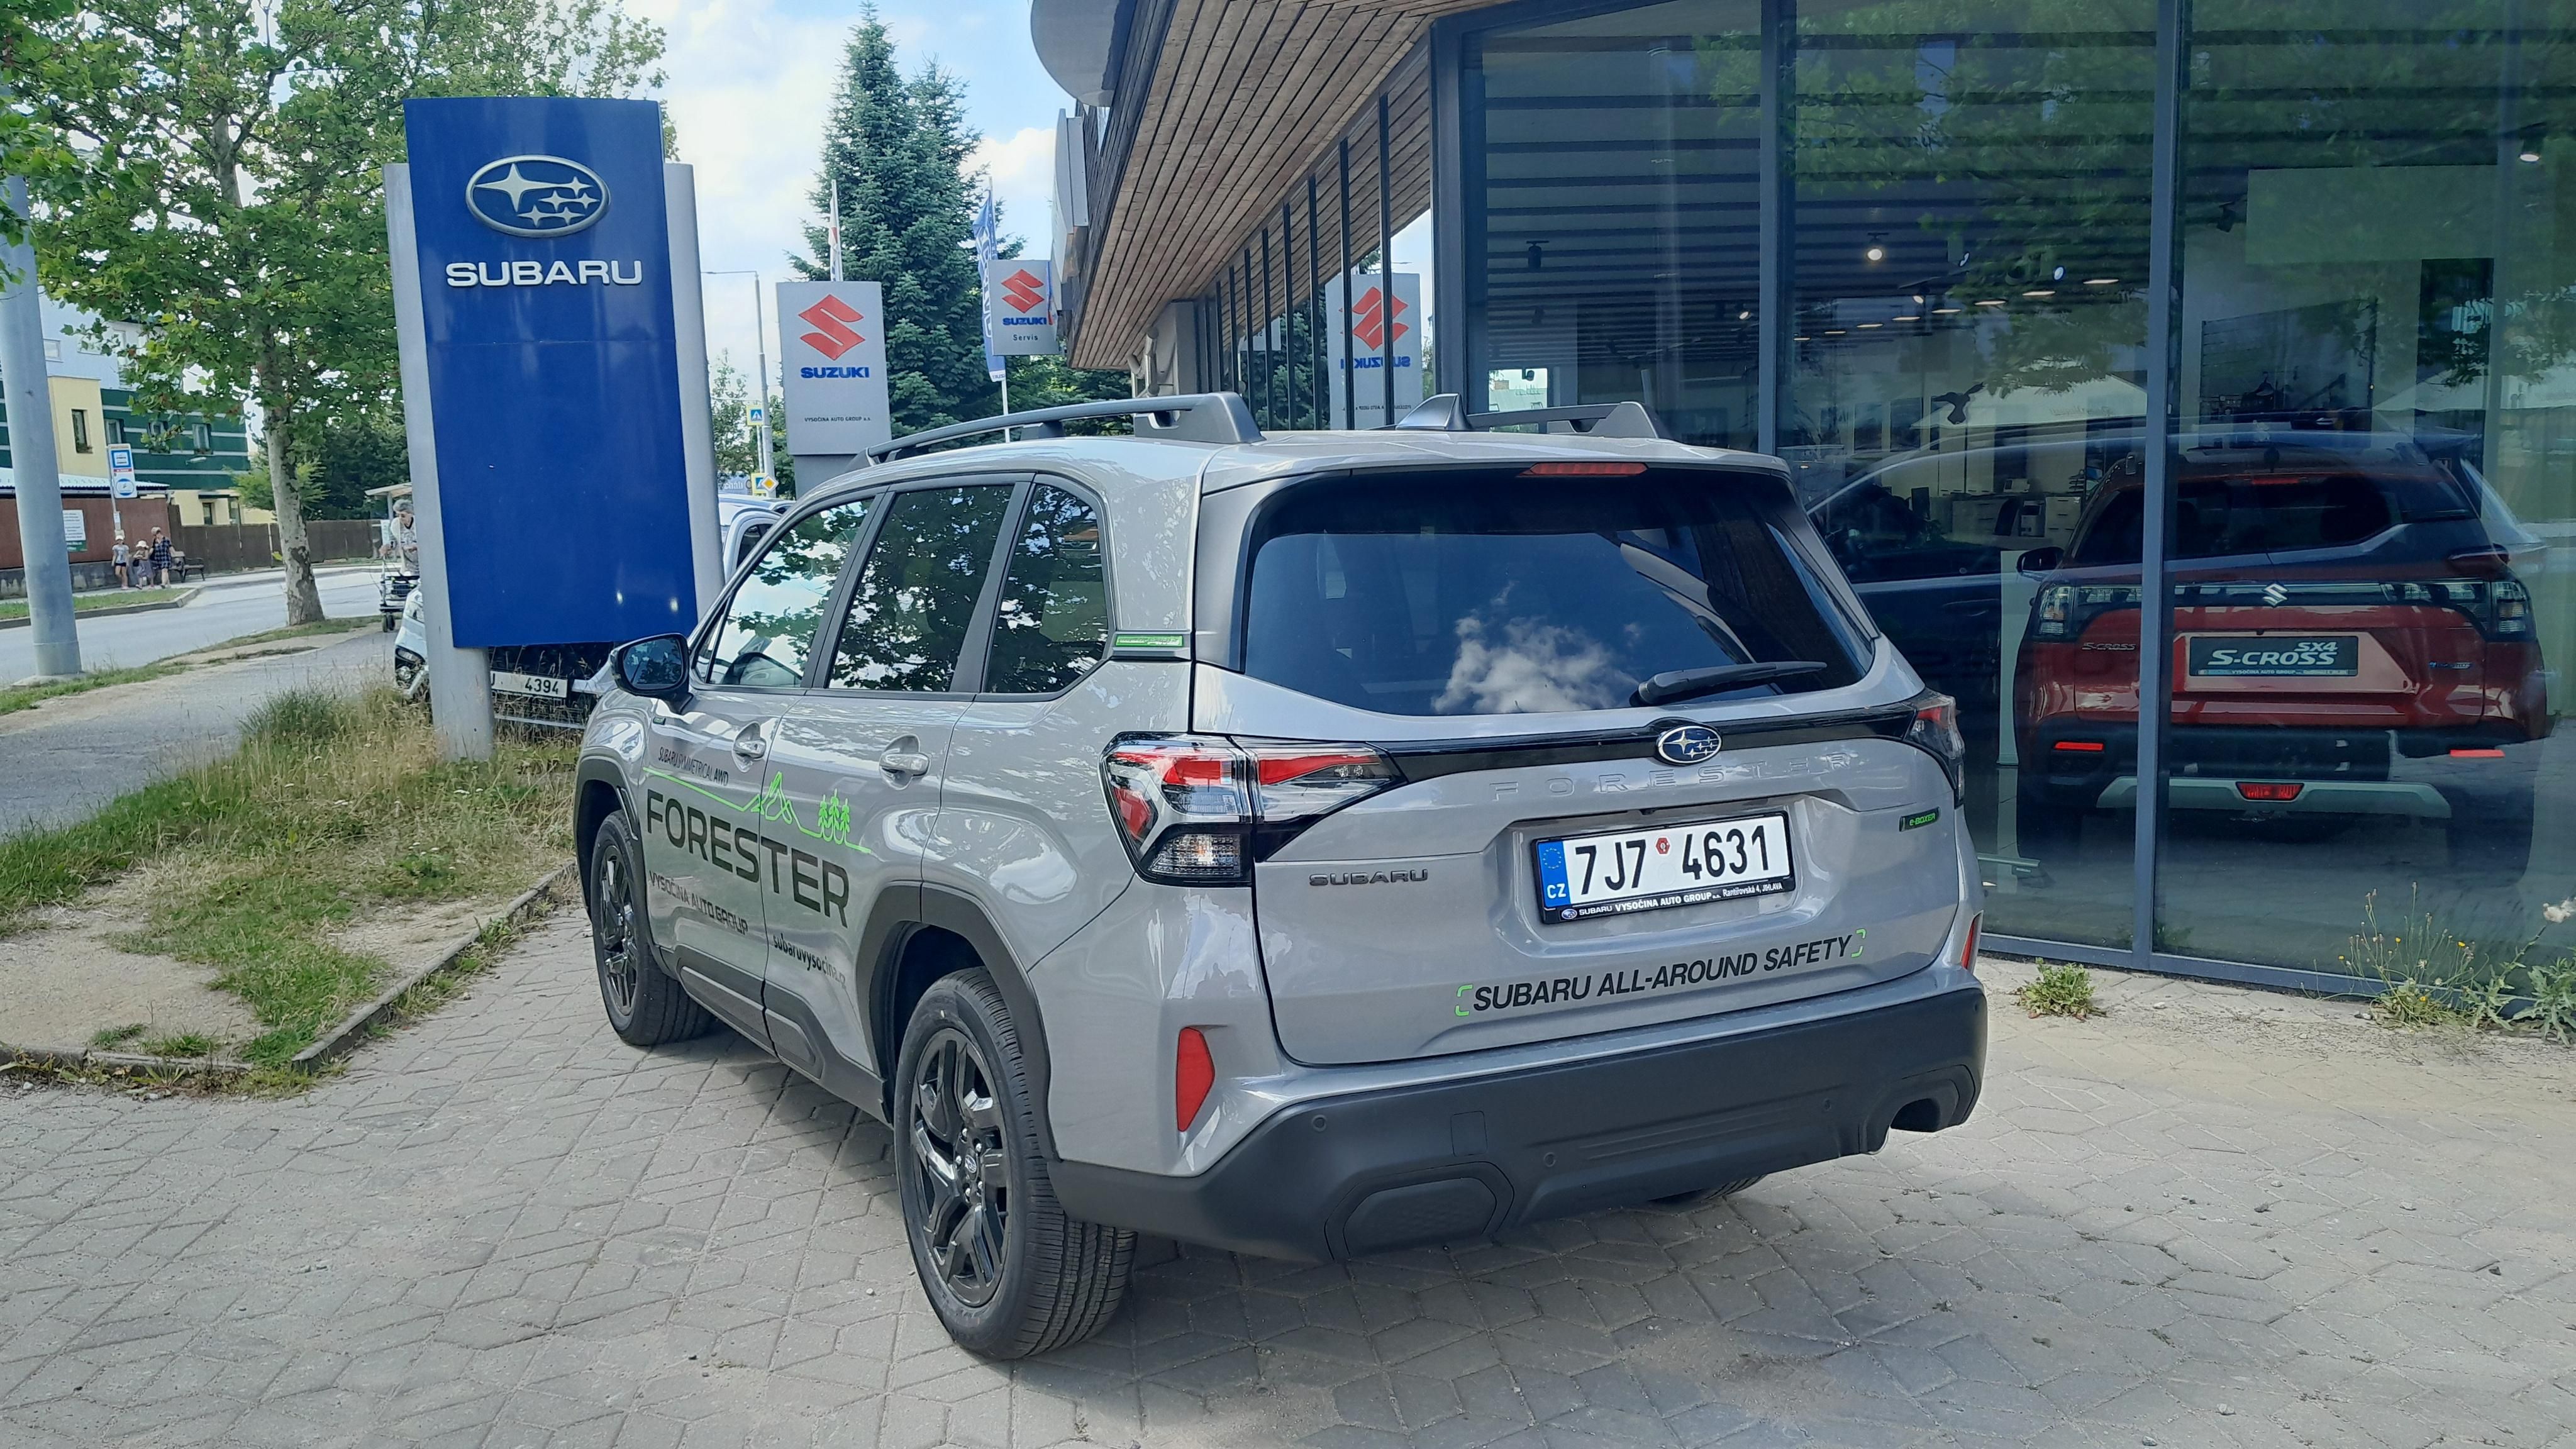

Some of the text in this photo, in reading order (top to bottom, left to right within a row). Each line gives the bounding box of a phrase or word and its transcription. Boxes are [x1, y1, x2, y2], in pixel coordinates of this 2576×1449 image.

[446, 260, 642, 286] SUBARU
[1002, 317, 1047, 326] SUZUKI
[801, 367, 870, 378] SUZUKI
[2082, 642, 2136, 651] S-CROSS
[2294, 641, 2338, 652] SX4
[2207, 650, 2338, 665] S-CROSS
[525, 677, 559, 695] 4394
[658, 747, 729, 786] SUBARU SYMMETRICAL AWD
[1489, 753, 1852, 801] FORESTER
[1909, 813, 1936, 826] e-BOXER
[647, 789, 850, 928] FORESTER
[1575, 825, 1768, 895] 7J7 4631
[1309, 869, 1428, 886] SUBARU
[1546, 884, 1567, 899] CZ
[1579, 906, 1613, 916] SUBARU
[1614, 897, 1658, 912] VYSOČINA
[1660, 896, 1682, 906] AUTO
[1684, 892, 1712, 903] GROUP
[1755, 886, 1762, 894] 4,
[1762, 882, 1783, 892] JIHLAVA
[649, 870, 748, 935] VYSOČINA AUTO GROUP
[1473, 935, 1853, 1011] SUBARU ALL-AROUND SAFETY
